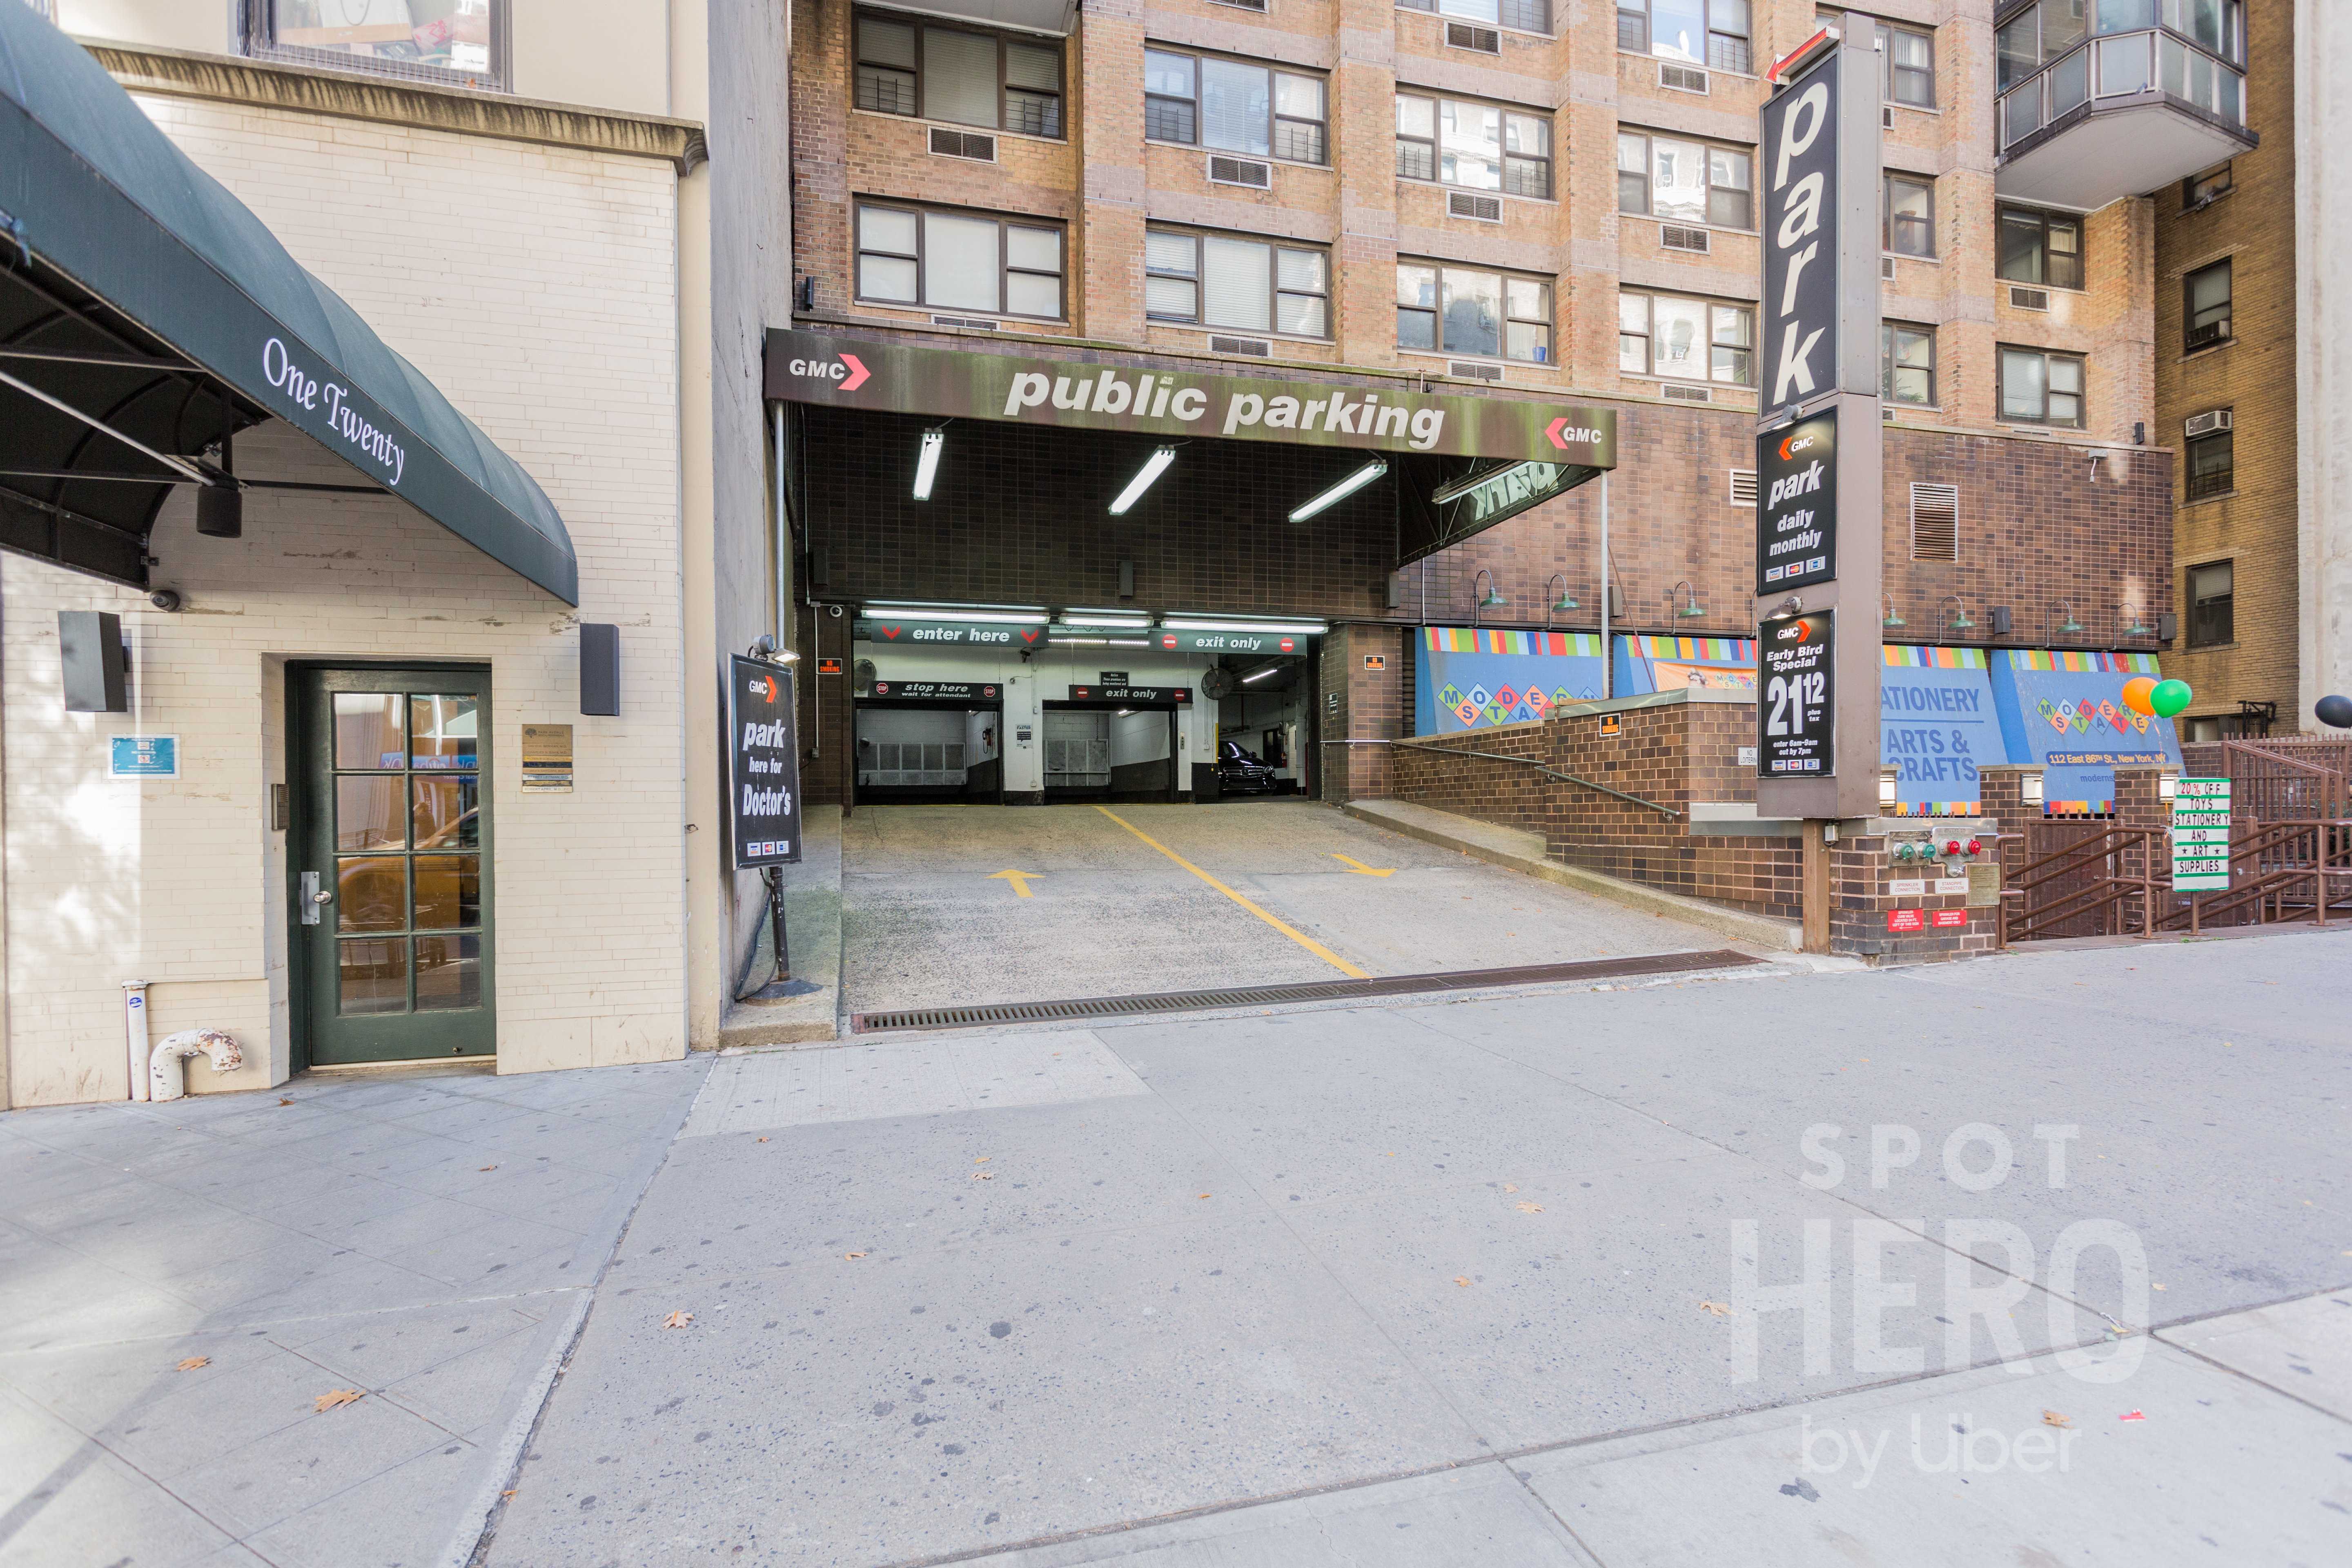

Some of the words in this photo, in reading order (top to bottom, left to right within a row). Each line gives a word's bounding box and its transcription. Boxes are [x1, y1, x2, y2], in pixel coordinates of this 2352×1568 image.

[1773, 82, 1829, 405] park
[790, 359, 845, 380] GMC
[262, 338, 318, 410] One
[324, 383, 405, 486] Twenty
[1003, 370, 1207, 421] public
[1222, 391, 1445, 450] parking
[1564, 427, 1602, 444] GMC
[1791, 436, 1814, 452] GMC
[1767, 460, 1824, 510] park
[1777, 509, 1814, 532] daily
[1769, 530, 1822, 557] monthly
[913, 628, 962, 641] enter
[969, 628, 1010, 642] here
[1777, 627, 1799, 640] GMC
[1196, 636, 1225, 648] exit
[1230, 637, 1261, 650] only
[1766, 649, 1795, 662] Early
[1797, 644, 1824, 657] Bird
[1773, 656, 1817, 672] Special
[749, 680, 768, 695] GMC
[905, 683, 934, 692] stop
[939, 684, 968, 692] here
[1106, 689, 1128, 697] exit
[1133, 689, 1157, 699] only
[1881, 686, 1979, 712] ATIONERY
[1463, 706, 1530, 720] STA
[2040, 704, 2132, 716] MODER
[1607, 717, 1613, 725] NO
[2056, 717, 2145, 728] STATE
[742, 719, 786, 751] park
[1602, 724, 1619, 734] SMOKING
[1789, 739, 1818, 747] 6am-9am
[1887, 729, 1944, 754] ARTS
[1951, 729, 1970, 754] &
[1798, 747, 1812, 755] 7pm
[749, 757, 768, 773] here
[770, 757, 782, 774] for
[2049, 754, 2066, 764] 112
[2067, 754, 2084, 764] East
[2104, 754, 2117, 764] St.,
[2118, 754, 2135, 763] New
[2135, 754, 2155, 764] York,
[2155, 755, 2166, 763] NY
[742, 784, 791, 816] Doctor's
[2190, 798, 2213, 810] TOYS
[2175, 813, 2229, 826] STATIONERY
[2191, 830, 2207, 842] AND
[2193, 845, 2208, 857] ART
[2180, 860, 2219, 873] SUPPLIES
